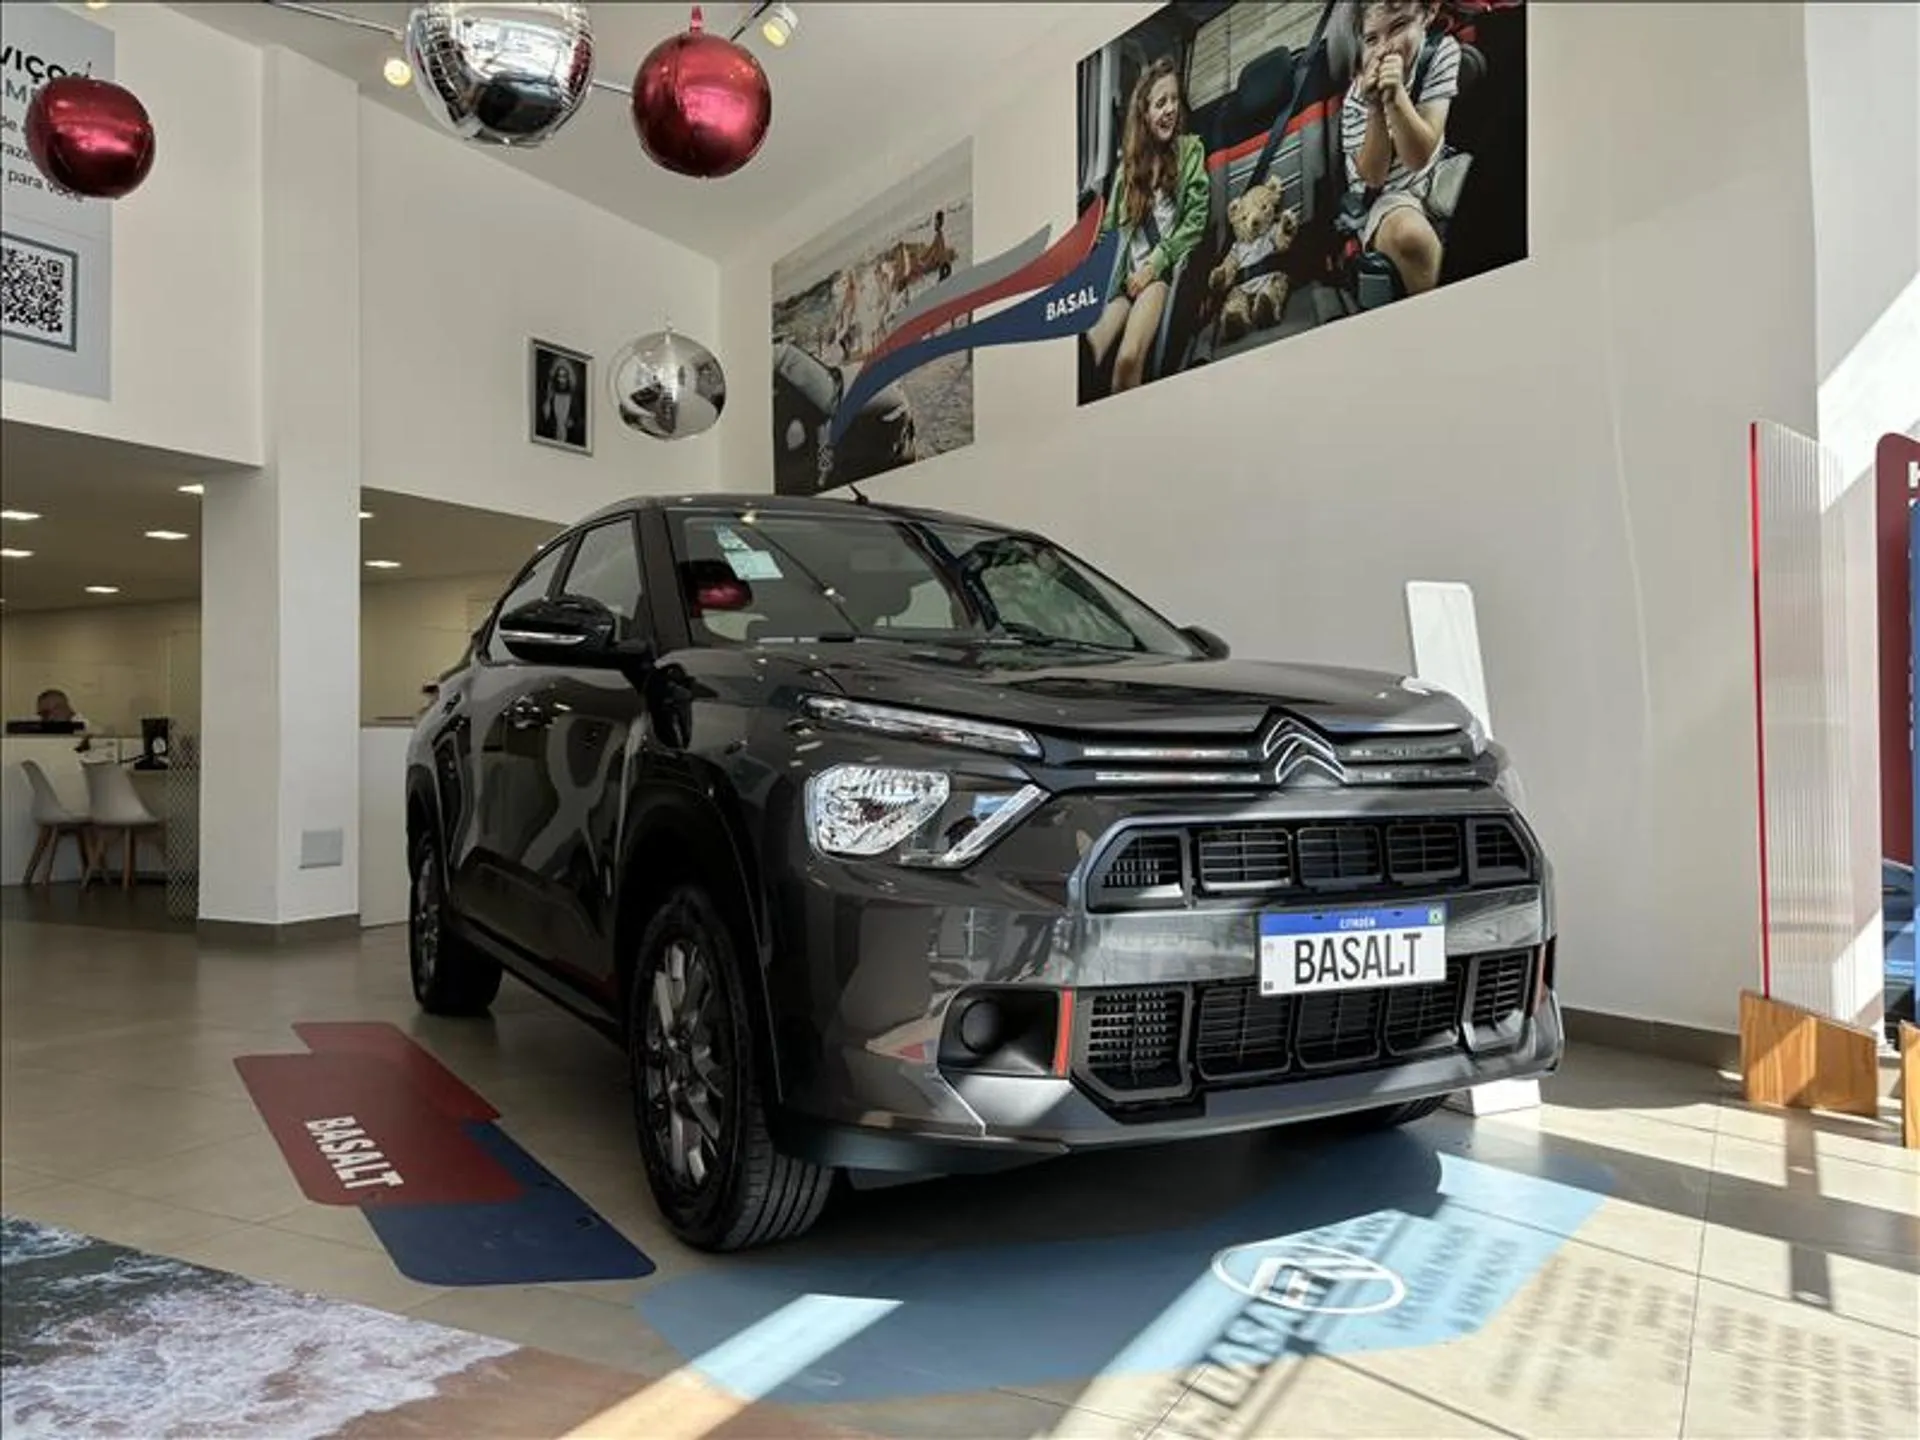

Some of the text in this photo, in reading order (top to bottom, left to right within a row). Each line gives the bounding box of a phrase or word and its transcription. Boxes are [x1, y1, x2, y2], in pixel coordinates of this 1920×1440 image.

[8, 170, 43, 189] para
[1294, 932, 1422, 985] BASALT
[304, 1116, 404, 1189] BASALT
